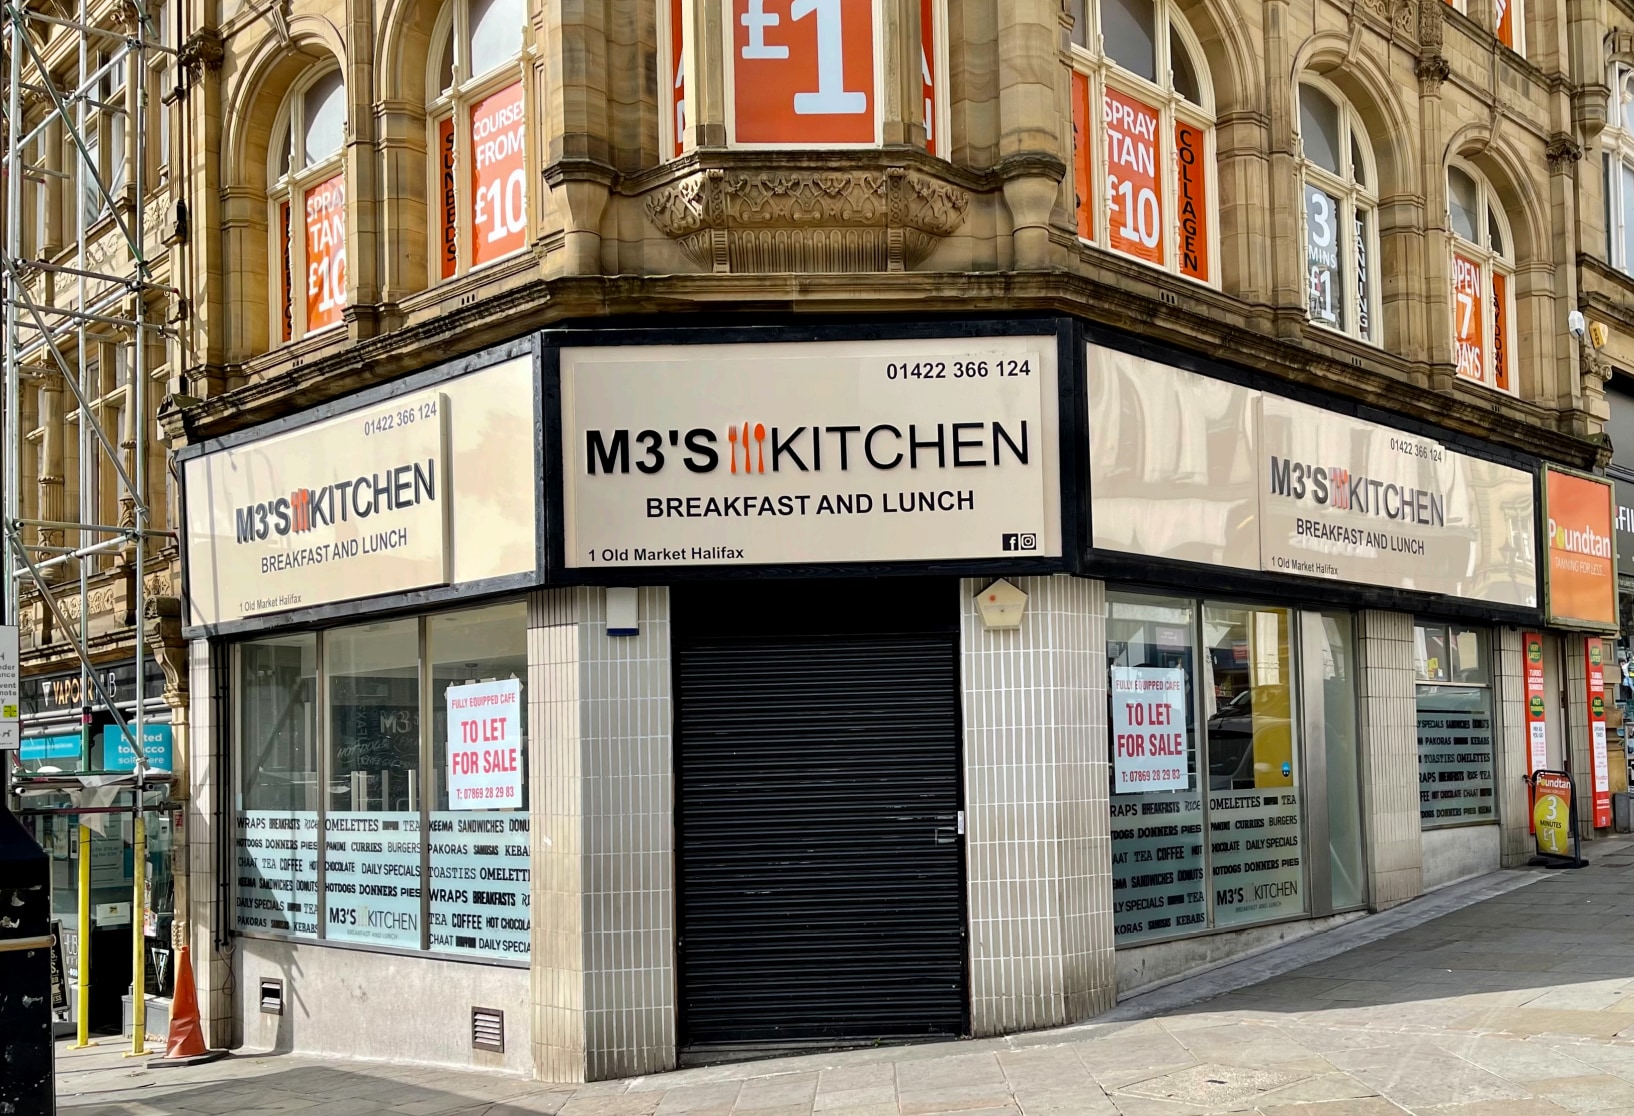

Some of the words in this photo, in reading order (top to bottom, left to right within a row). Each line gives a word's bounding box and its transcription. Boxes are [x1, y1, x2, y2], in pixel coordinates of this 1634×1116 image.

[740, 0, 867, 114] £1
[473, 101, 525, 141] COURSES
[1104, 96, 1156, 142] SPRAY
[476, 125, 525, 170] FROM
[1108, 128, 1154, 178] TAN
[475, 169, 526, 243] £10
[1179, 129, 1197, 272] COLLAGEN
[1108, 174, 1159, 248] £10
[1311, 193, 1330, 247] 3
[310, 215, 344, 253] TAN
[1308, 244, 1336, 269] MINS
[309, 249, 347, 312] £10
[1355, 220, 1368, 327] TANNING
[1453, 259, 1480, 298] OPEN
[1310, 266, 1335, 322] £1
[1458, 293, 1472, 339] 7
[887, 362, 946, 379] 01422
[954, 361, 989, 378] 366
[997, 360, 1031, 377] 124
[1456, 341, 1480, 378] DAYS
[364, 413, 393, 436] 01422
[397, 408, 415, 427] 366
[418, 401, 437, 421] 124
[586, 428, 719, 475] M3'S
[772, 420, 1029, 472] KITCHEN
[1391, 438, 1412, 455] 01422
[1415, 445, 1427, 459] 366
[1430, 449, 1441, 462] 124
[235, 497, 292, 544] M3'S
[311, 458, 434, 528] KITCHEN
[1270, 456, 1328, 504] M3'S
[1348, 474, 1444, 527] KITCHEN
[646, 495, 810, 518] BREAKFAST
[816, 493, 873, 514] AND
[882, 490, 975, 513] LUNCH
[1297, 518, 1364, 545] BREAKFAST
[1366, 532, 1387, 549] AND
[1391, 535, 1424, 555] LUNCH
[1549, 518, 1611, 558] Poundtan
[261, 544, 330, 573] BREAKFAST
[333, 538, 359, 560] AND
[363, 527, 407, 554] LUNCH
[588, 549, 595, 561] 1
[602, 548, 629, 561] Old
[633, 547, 688, 561] Market
[691, 546, 744, 560] Halifax
[1271, 556, 1275, 566] 1
[1278, 557, 1289, 568] Old
[1292, 559, 1314, 572] Market
[1316, 563, 1338, 575] Halifax
[1555, 557, 1578, 572] TANNING
[1580, 561, 1590, 574] FOR
[240, 602, 242, 612] 1
[245, 601, 255, 611] Old
[257, 599, 277, 609] Market
[279, 594, 301, 606] Halifax
[1116, 680, 1133, 689] FULLY
[1135, 680, 1163, 690] EQUIPPED
[1165, 680, 1180, 690] CAFE
[452, 699, 468, 709] FULLY
[470, 694, 498, 708] EQUIPPED
[500, 693, 515, 703] CAFE
[1126, 703, 1143, 726] TO
[1148, 703, 1171, 725] LET
[461, 720, 478, 743] TO
[483, 717, 506, 741] LET
[1118, 734, 1145, 757] FOR
[1149, 733, 1182, 756] SALE
[453, 752, 478, 775] FOR
[484, 749, 516, 773] SALE
[1122, 772, 1128, 782] T:
[1130, 771, 1150, 782] 07869
[1152, 770, 1160, 780] 28
[1162, 770, 1170, 780] 29
[1172, 769, 1180, 779] 83
[1537, 775, 1570, 788] Poundtan
[457, 789, 462, 800] T:
[464, 787, 483, 799] 07869
[485, 787, 493, 798] 28
[496, 786, 504, 798] 29
[506, 786, 514, 798] 83
[1210, 796, 1260, 810] OMELETTES
[1282, 795, 1296, 805] TEA
[1142, 801, 1180, 815] BREAKFASTS
[1546, 796, 1557, 819] 3
[237, 817, 265, 829] WRAPS
[325, 818, 379, 831] OMELETTES
[403, 820, 420, 831] TEA
[428, 820, 453, 832] KEEMA
[458, 820, 504, 833] SANDWICHES
[1138, 826, 1178, 839] DONNERS
[1181, 825, 1201, 834] PIES
[1235, 819, 1265, 830] CURRIES
[1269, 815, 1297, 827] BURGERS
[1540, 820, 1561, 828] MINUTES
[265, 839, 298, 850] DONNERS
[301, 841, 318, 850] PIES
[326, 842, 346, 851] PANINI
[351, 842, 382, 852] CURRIES
[388, 842, 420, 853] BURGERS
[428, 844, 468, 855] PAKORAS
[1246, 839, 1265, 851] DAILY
[1266, 836, 1297, 848] SPECIALS
[1543, 829, 1558, 851] £1
[1134, 850, 1152, 863] TEA
[1157, 846, 1184, 861] COFFEE
[262, 859, 276, 869] TEA
[280, 858, 302, 872] COFFEE
[325, 861, 355, 872] CHOCOLATE
[362, 863, 382, 874] DAILY
[384, 864, 420, 876] SPECIALS
[428, 867, 476, 879] TOASTIES
[1244, 860, 1279, 873] DONNERS
[1282, 858, 1299, 867] PIES
[325, 883, 356, 893] HOTDOGS
[359, 884, 397, 897] DONNERS
[400, 888, 421, 897] PIES
[429, 888, 468, 903] WRAPS
[473, 891, 515, 906] BREAKFASTS
[1217, 888, 1243, 907] M3'S
[1254, 881, 1297, 900] KITCHEN
[237, 897, 253, 908] DAILY
[255, 898, 284, 911] SPECIALS
[1126, 896, 1164, 912] SPECIALS
[1187, 892, 1204, 904] TEA
[237, 916, 267, 927] PAKORAS
[294, 922, 318, 933] KEBABS
[329, 907, 356, 925] M3'S
[368, 910, 417, 931] KITCHEN
[428, 913, 447, 925] TEA
[452, 913, 482, 930] COFFEE
[486, 917, 499, 928] HOT
[1176, 912, 1205, 926] KEBABS
[429, 934, 454, 945] CHAAT
[479, 938, 500, 950] DAILY
